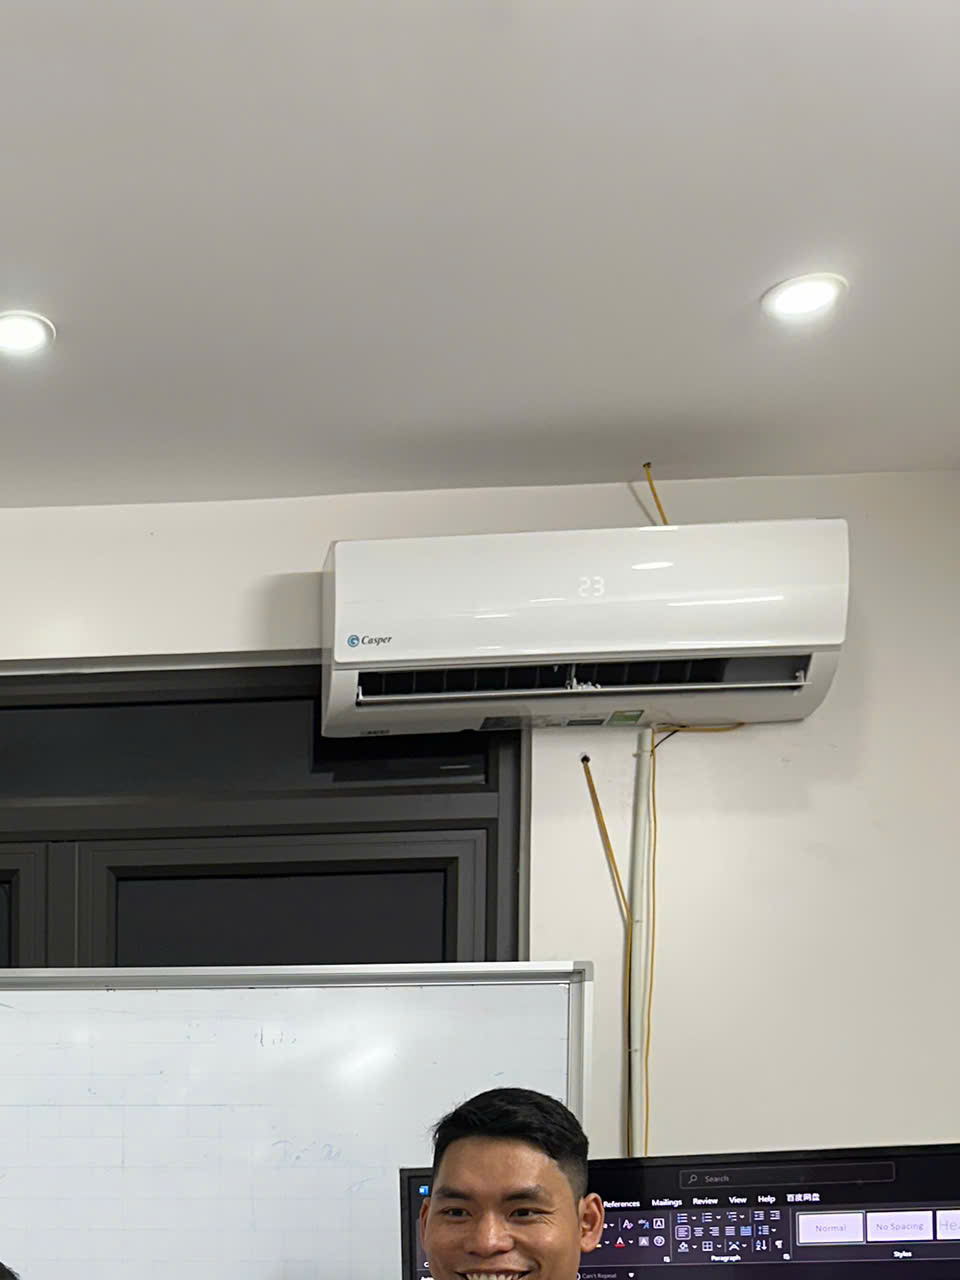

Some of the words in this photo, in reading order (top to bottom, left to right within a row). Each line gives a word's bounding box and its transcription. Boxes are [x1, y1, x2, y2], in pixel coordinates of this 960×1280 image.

[578, 576, 605, 597] 23
[361, 635, 392, 646] Casper
[705, 1175, 729, 1183] Search
[652, 1199, 683, 1208] Mailings
[693, 1197, 718, 1205] Review
[729, 1196, 748, 1204] View
[758, 1195, 776, 1204] Help
[815, 1224, 847, 1232] Normal
[876, 1223, 889, 1231] No
[890, 1222, 924, 1232] Spacing
[711, 1255, 741, 1263] Paragraph
[893, 1251, 912, 1259] Styles
